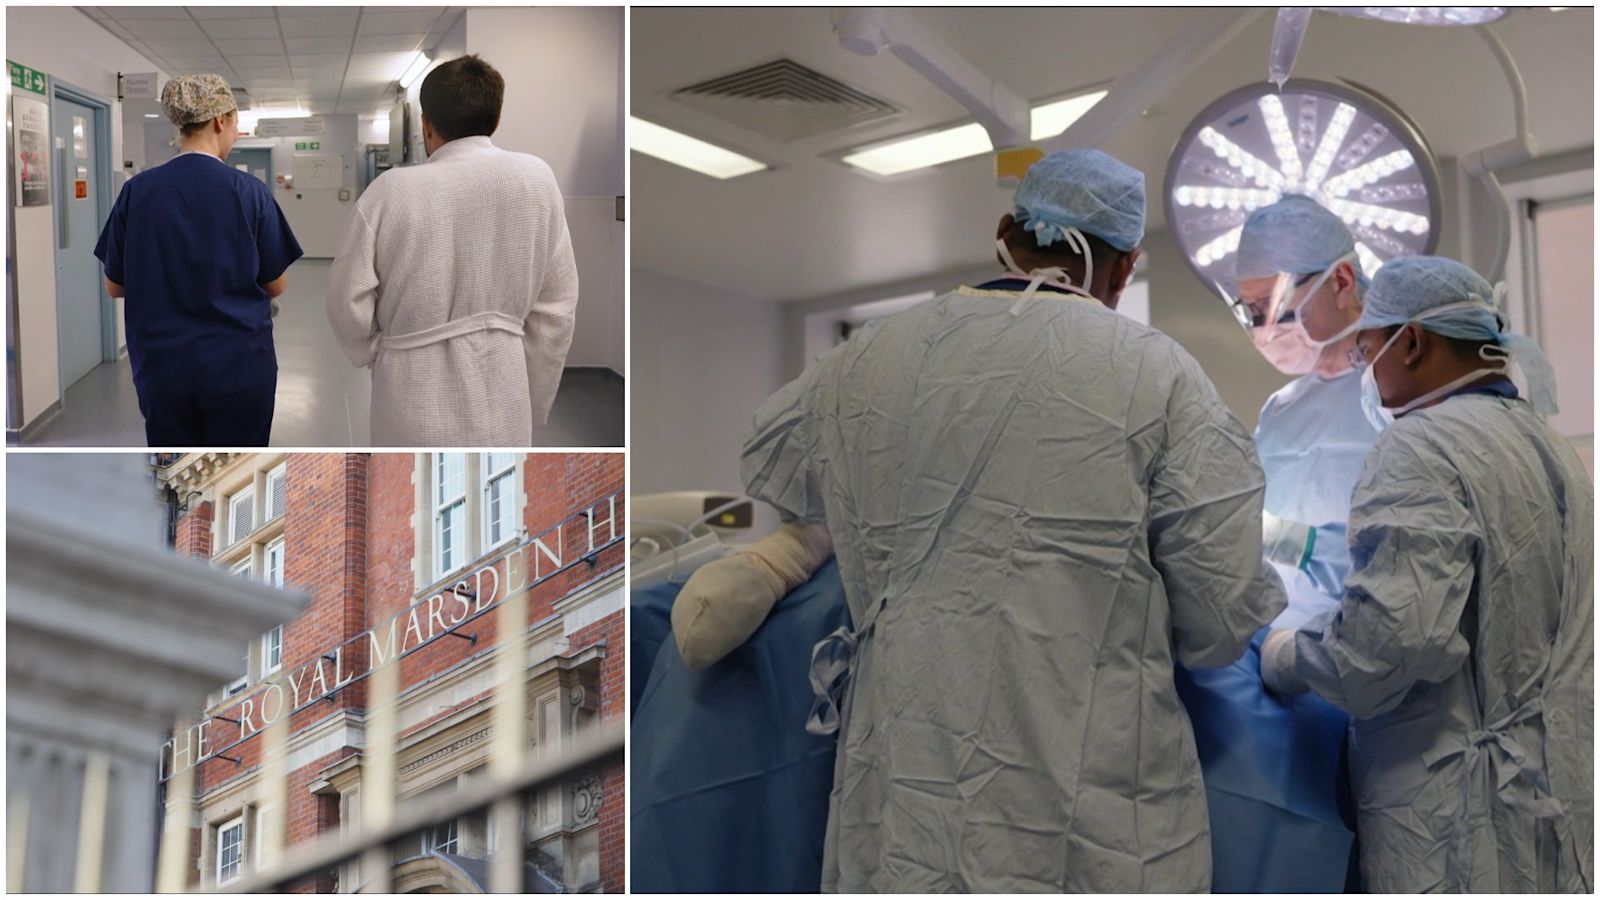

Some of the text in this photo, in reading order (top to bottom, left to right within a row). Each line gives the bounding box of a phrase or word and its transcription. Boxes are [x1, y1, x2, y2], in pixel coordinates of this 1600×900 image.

[158, 494, 616, 782] THE ROYAL MARSDEN H
